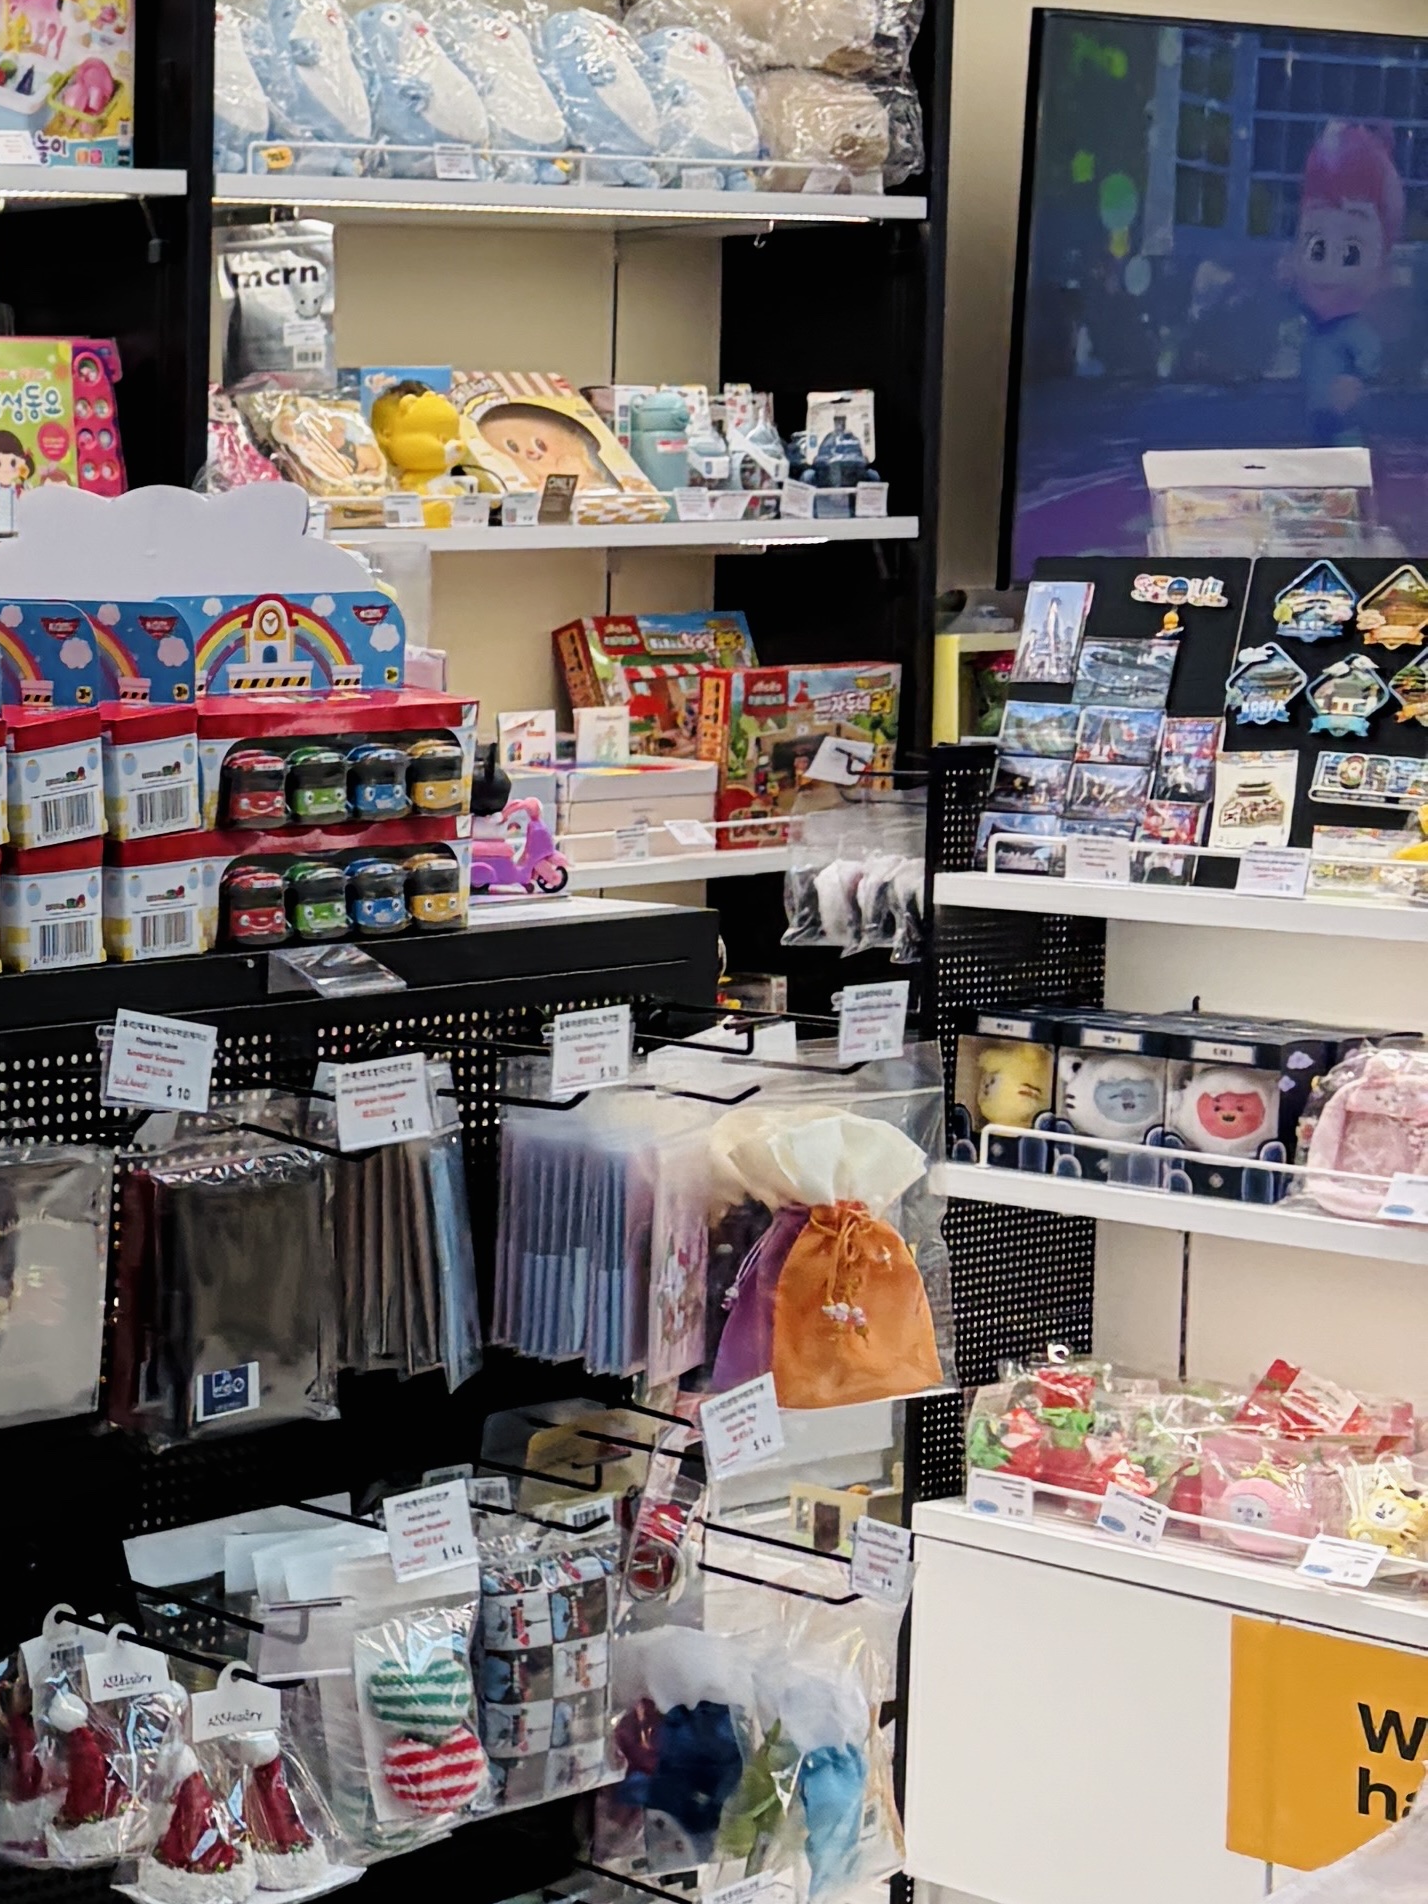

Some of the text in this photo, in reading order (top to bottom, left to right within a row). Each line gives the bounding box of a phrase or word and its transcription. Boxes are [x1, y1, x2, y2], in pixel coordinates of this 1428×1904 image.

[166, 1084, 191, 1101] $ 10
[392, 1120, 399, 1133] $
